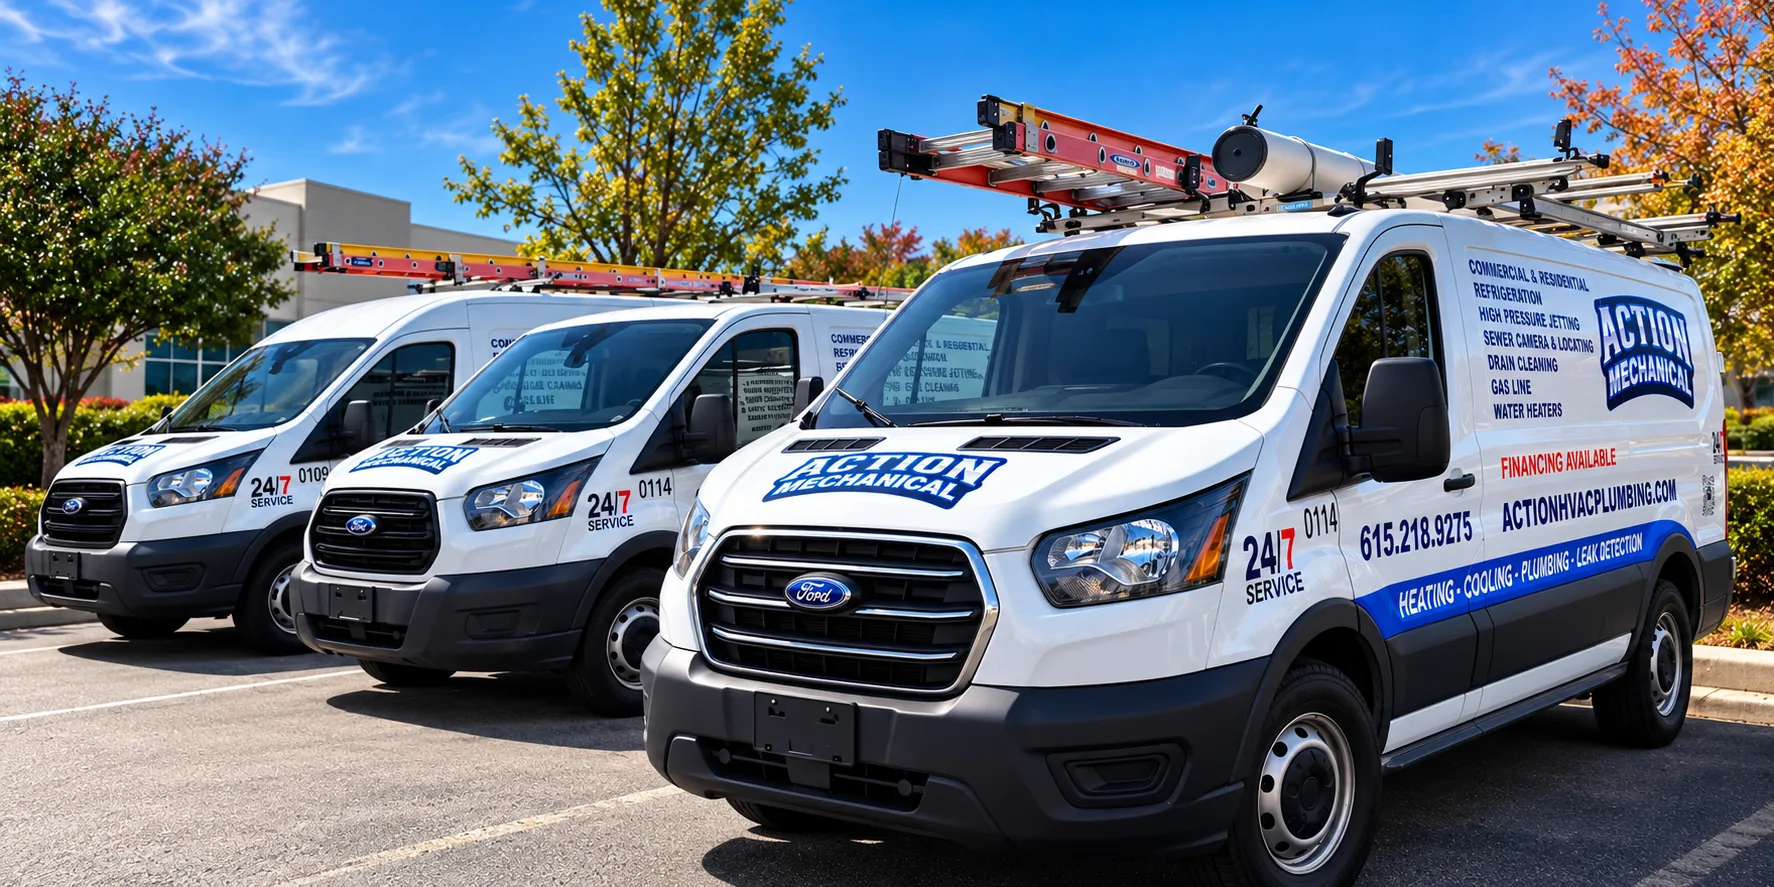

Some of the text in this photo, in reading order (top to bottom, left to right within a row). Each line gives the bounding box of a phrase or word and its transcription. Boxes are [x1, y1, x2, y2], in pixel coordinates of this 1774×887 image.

[1468, 259, 1590, 292] COMMERCIAL & RESIDENTIAL
[1473, 282, 1543, 305] REFRIGERATION
[1478, 306, 1581, 331] HIGH PRESSURE JETTING
[1483, 329, 1594, 353] SEWER CAMERA & LOCATING
[1598, 304, 1693, 370] ACTION
[1487, 354, 1558, 372] DRAIN CLEANING
[1608, 354, 1693, 398] MECHANICAL
[1491, 378, 1532, 395] GAS LINE
[1493, 402, 1563, 419] WATER HEATERS
[298, 466, 329, 483] 0109
[781, 454, 1000, 486] ACTION
[1501, 448, 1617, 479] FINANCING AVAILABLE
[250, 475, 291, 498] 24/7
[638, 477, 672, 498] 0114
[774, 472, 959, 501] MECHANICAL
[251, 495, 293, 508] SERVICE
[587, 489, 631, 519] 24/7
[1502, 479, 1677, 532] ACTIONHVACPLUMBING.COM
[588, 515, 634, 531] SERVICE
[1303, 502, 1338, 539] 0114
[1360, 511, 1473, 561] 615.218.9275
[1243, 527, 1295, 581] 24/7
[1246, 571, 1305, 605] SERVICE
[1398, 579, 1454, 619] HEATING
[1463, 565, 1513, 599] COOLING
[1521, 551, 1570, 583] PLUMBING
[1576, 542, 1599, 567] LEAK
[1599, 532, 1643, 560] DETECTION
[796, 582, 832, 603] Ford
